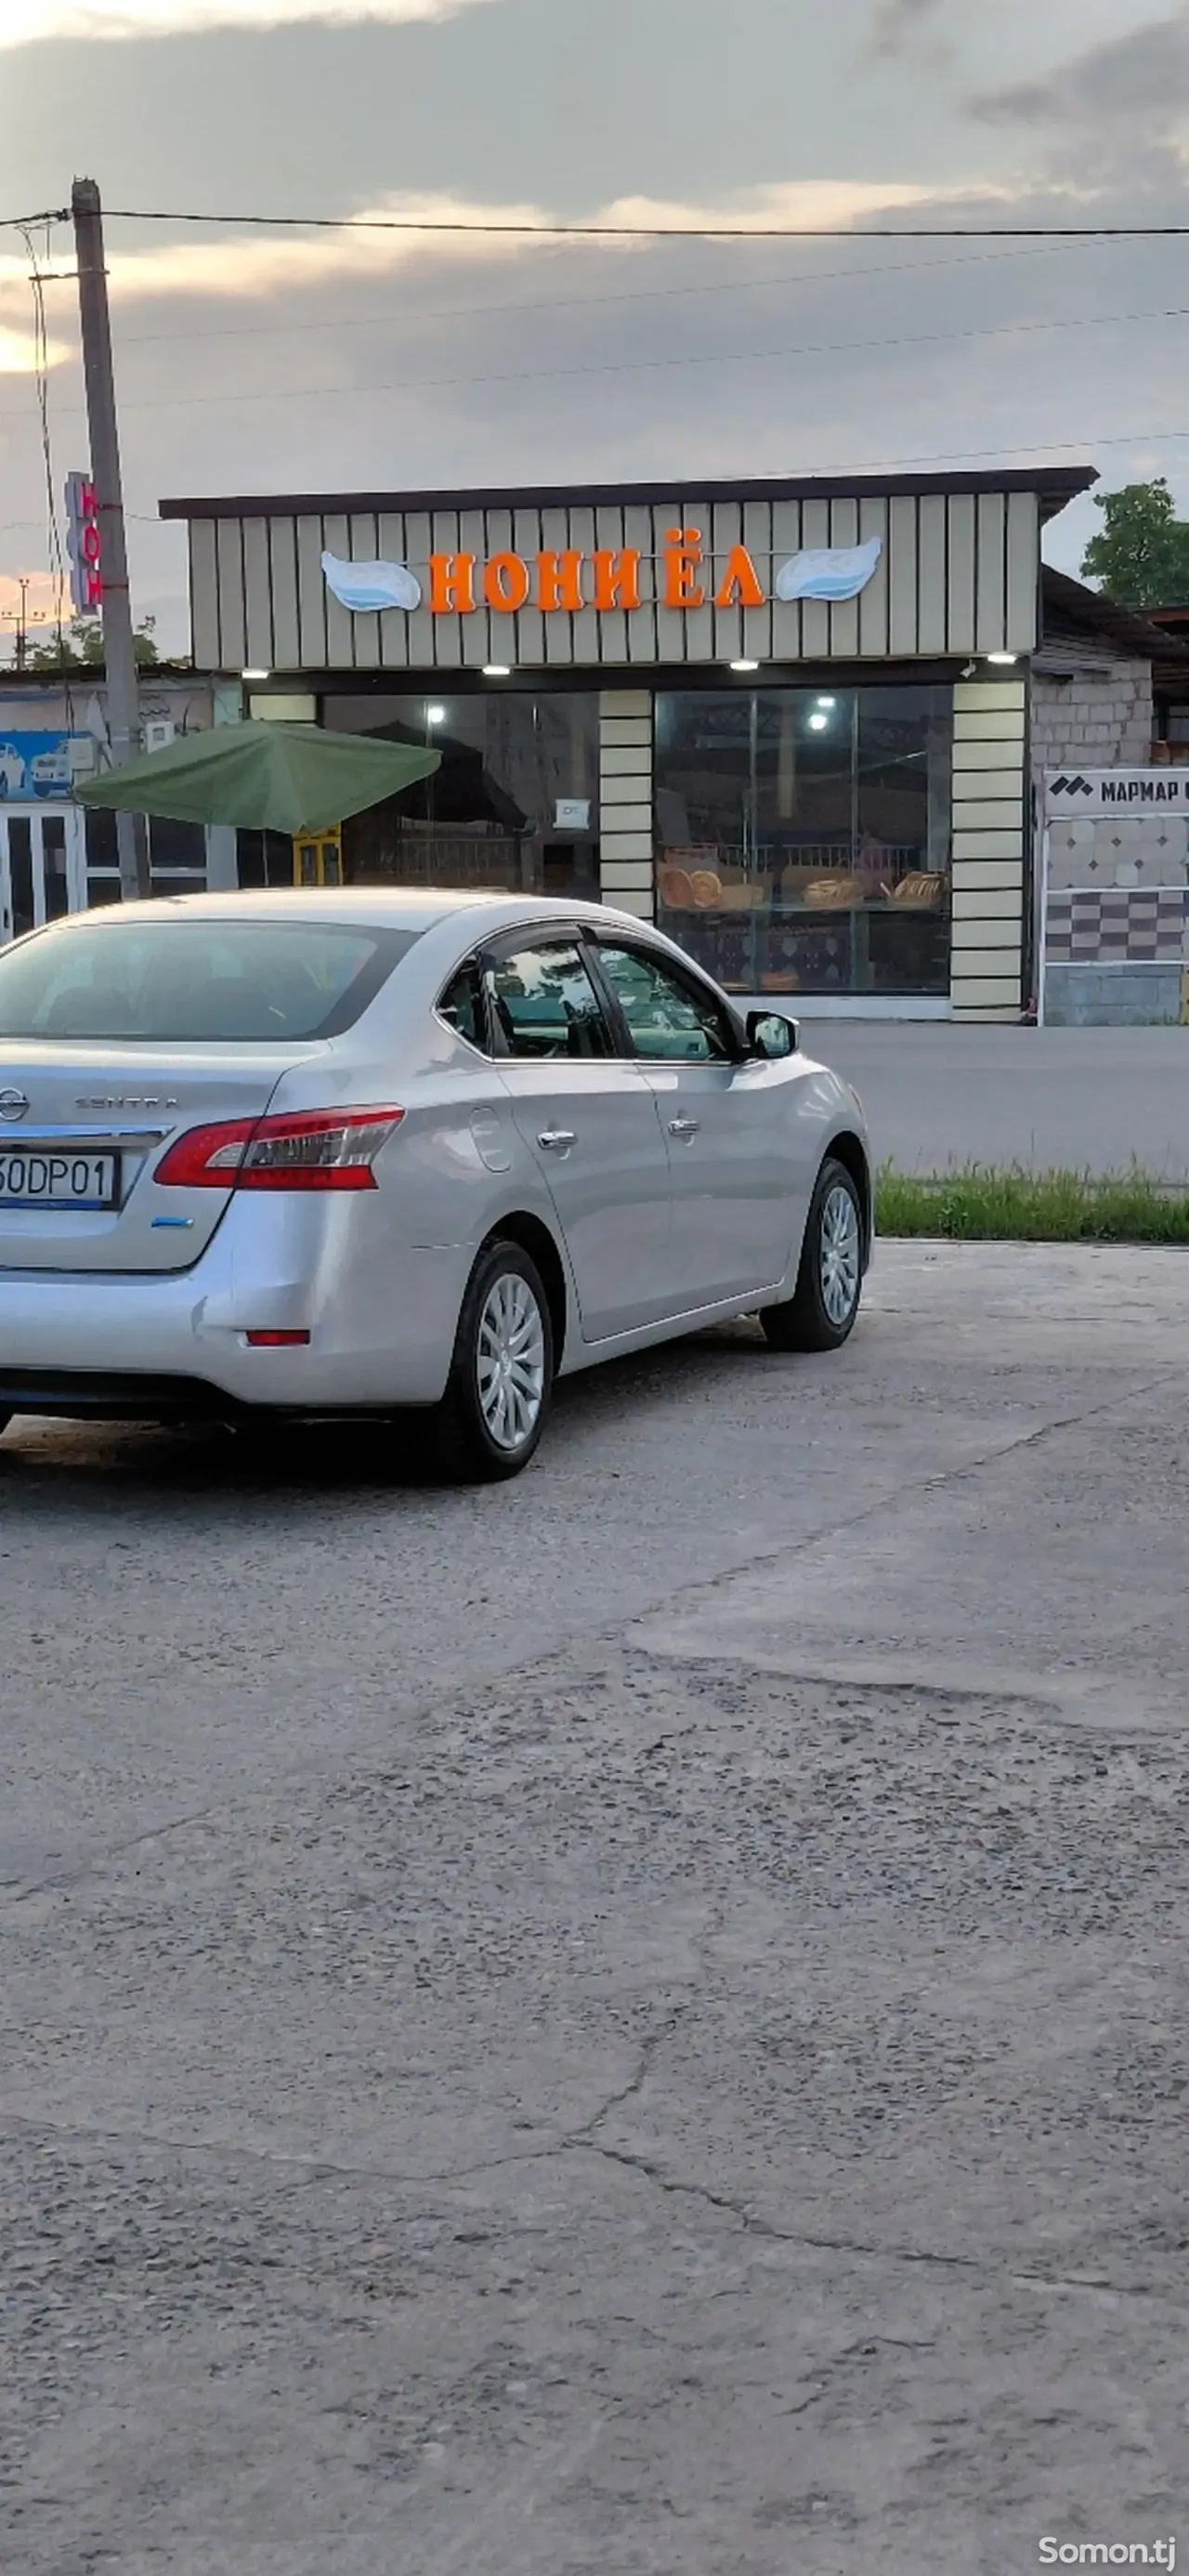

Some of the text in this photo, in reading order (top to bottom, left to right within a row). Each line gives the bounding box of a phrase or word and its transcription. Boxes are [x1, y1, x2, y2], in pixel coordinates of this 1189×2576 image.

[429, 528, 766, 614] НОНИ ЁЛ
[1101, 781, 1178, 801] МАРМАР
[74, 1097, 182, 1110] SENTRA
